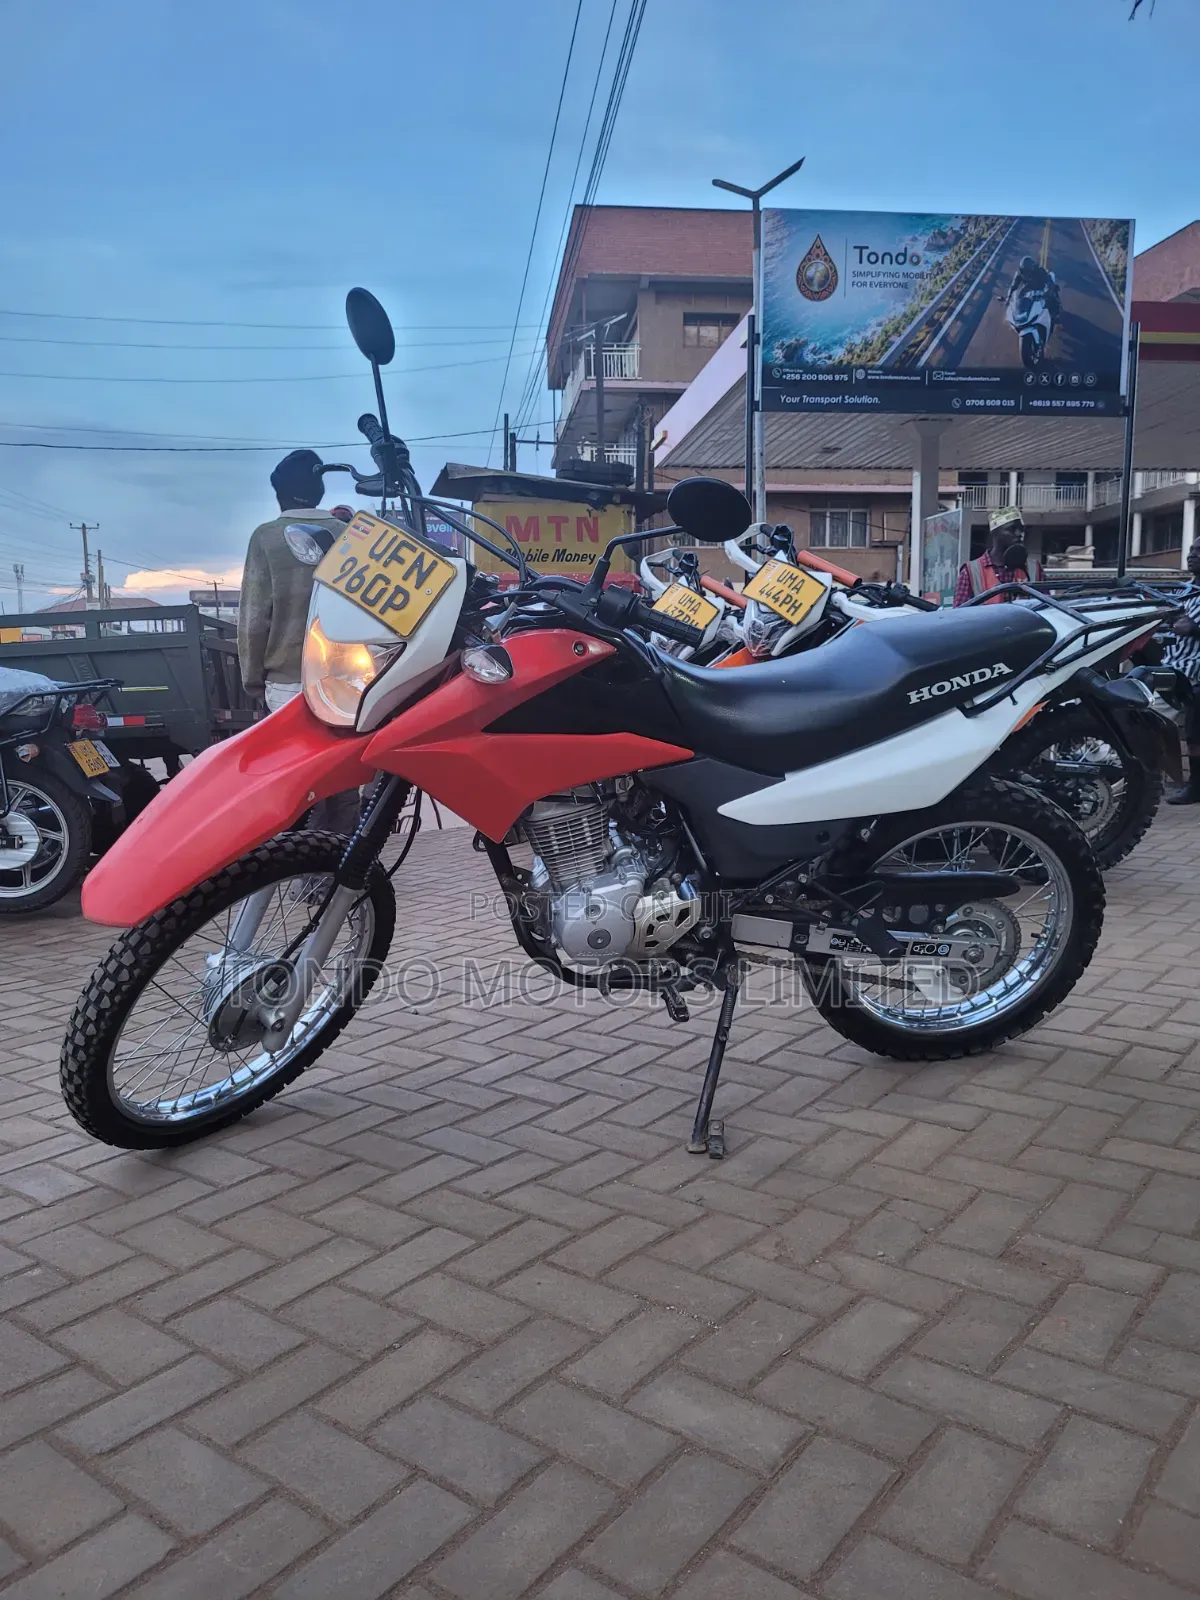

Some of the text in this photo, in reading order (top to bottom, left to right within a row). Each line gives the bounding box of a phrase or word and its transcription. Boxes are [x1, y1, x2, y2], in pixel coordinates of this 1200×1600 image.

[852, 245, 921, 266] Tondo
[852, 270, 937, 280] SIMPLIFYING MOBILITY
[869, 281, 909, 289] EVERYONE
[782, 373, 801, 381] +256
[780, 395, 881, 405] Your Transport Solution.
[505, 515, 600, 543] MTN
[368, 529, 438, 590] UFN
[551, 548, 597, 565] Money
[776, 568, 806, 595] UMA
[677, 592, 702, 615] UMA
[758, 583, 803, 617] 444PH
[906, 662, 1014, 705] HONDA
